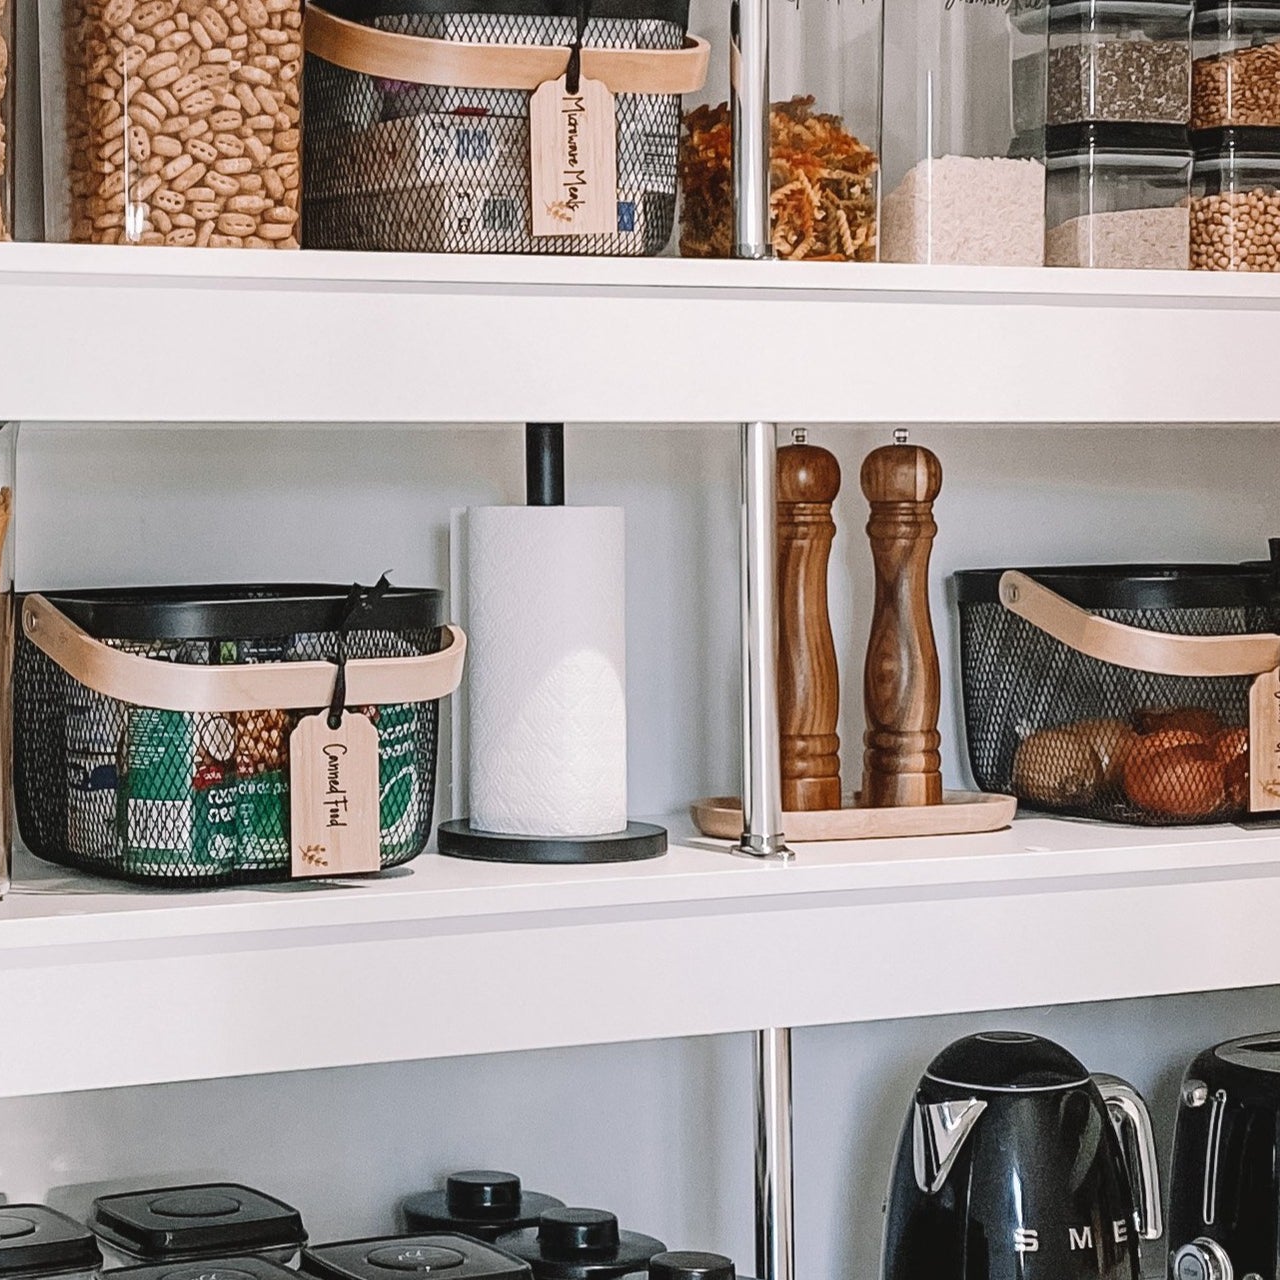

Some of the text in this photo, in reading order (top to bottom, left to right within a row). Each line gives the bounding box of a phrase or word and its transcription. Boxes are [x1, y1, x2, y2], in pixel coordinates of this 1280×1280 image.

[563, 170, 588, 212] Meals
[322, 743, 348, 828] Canned Food
